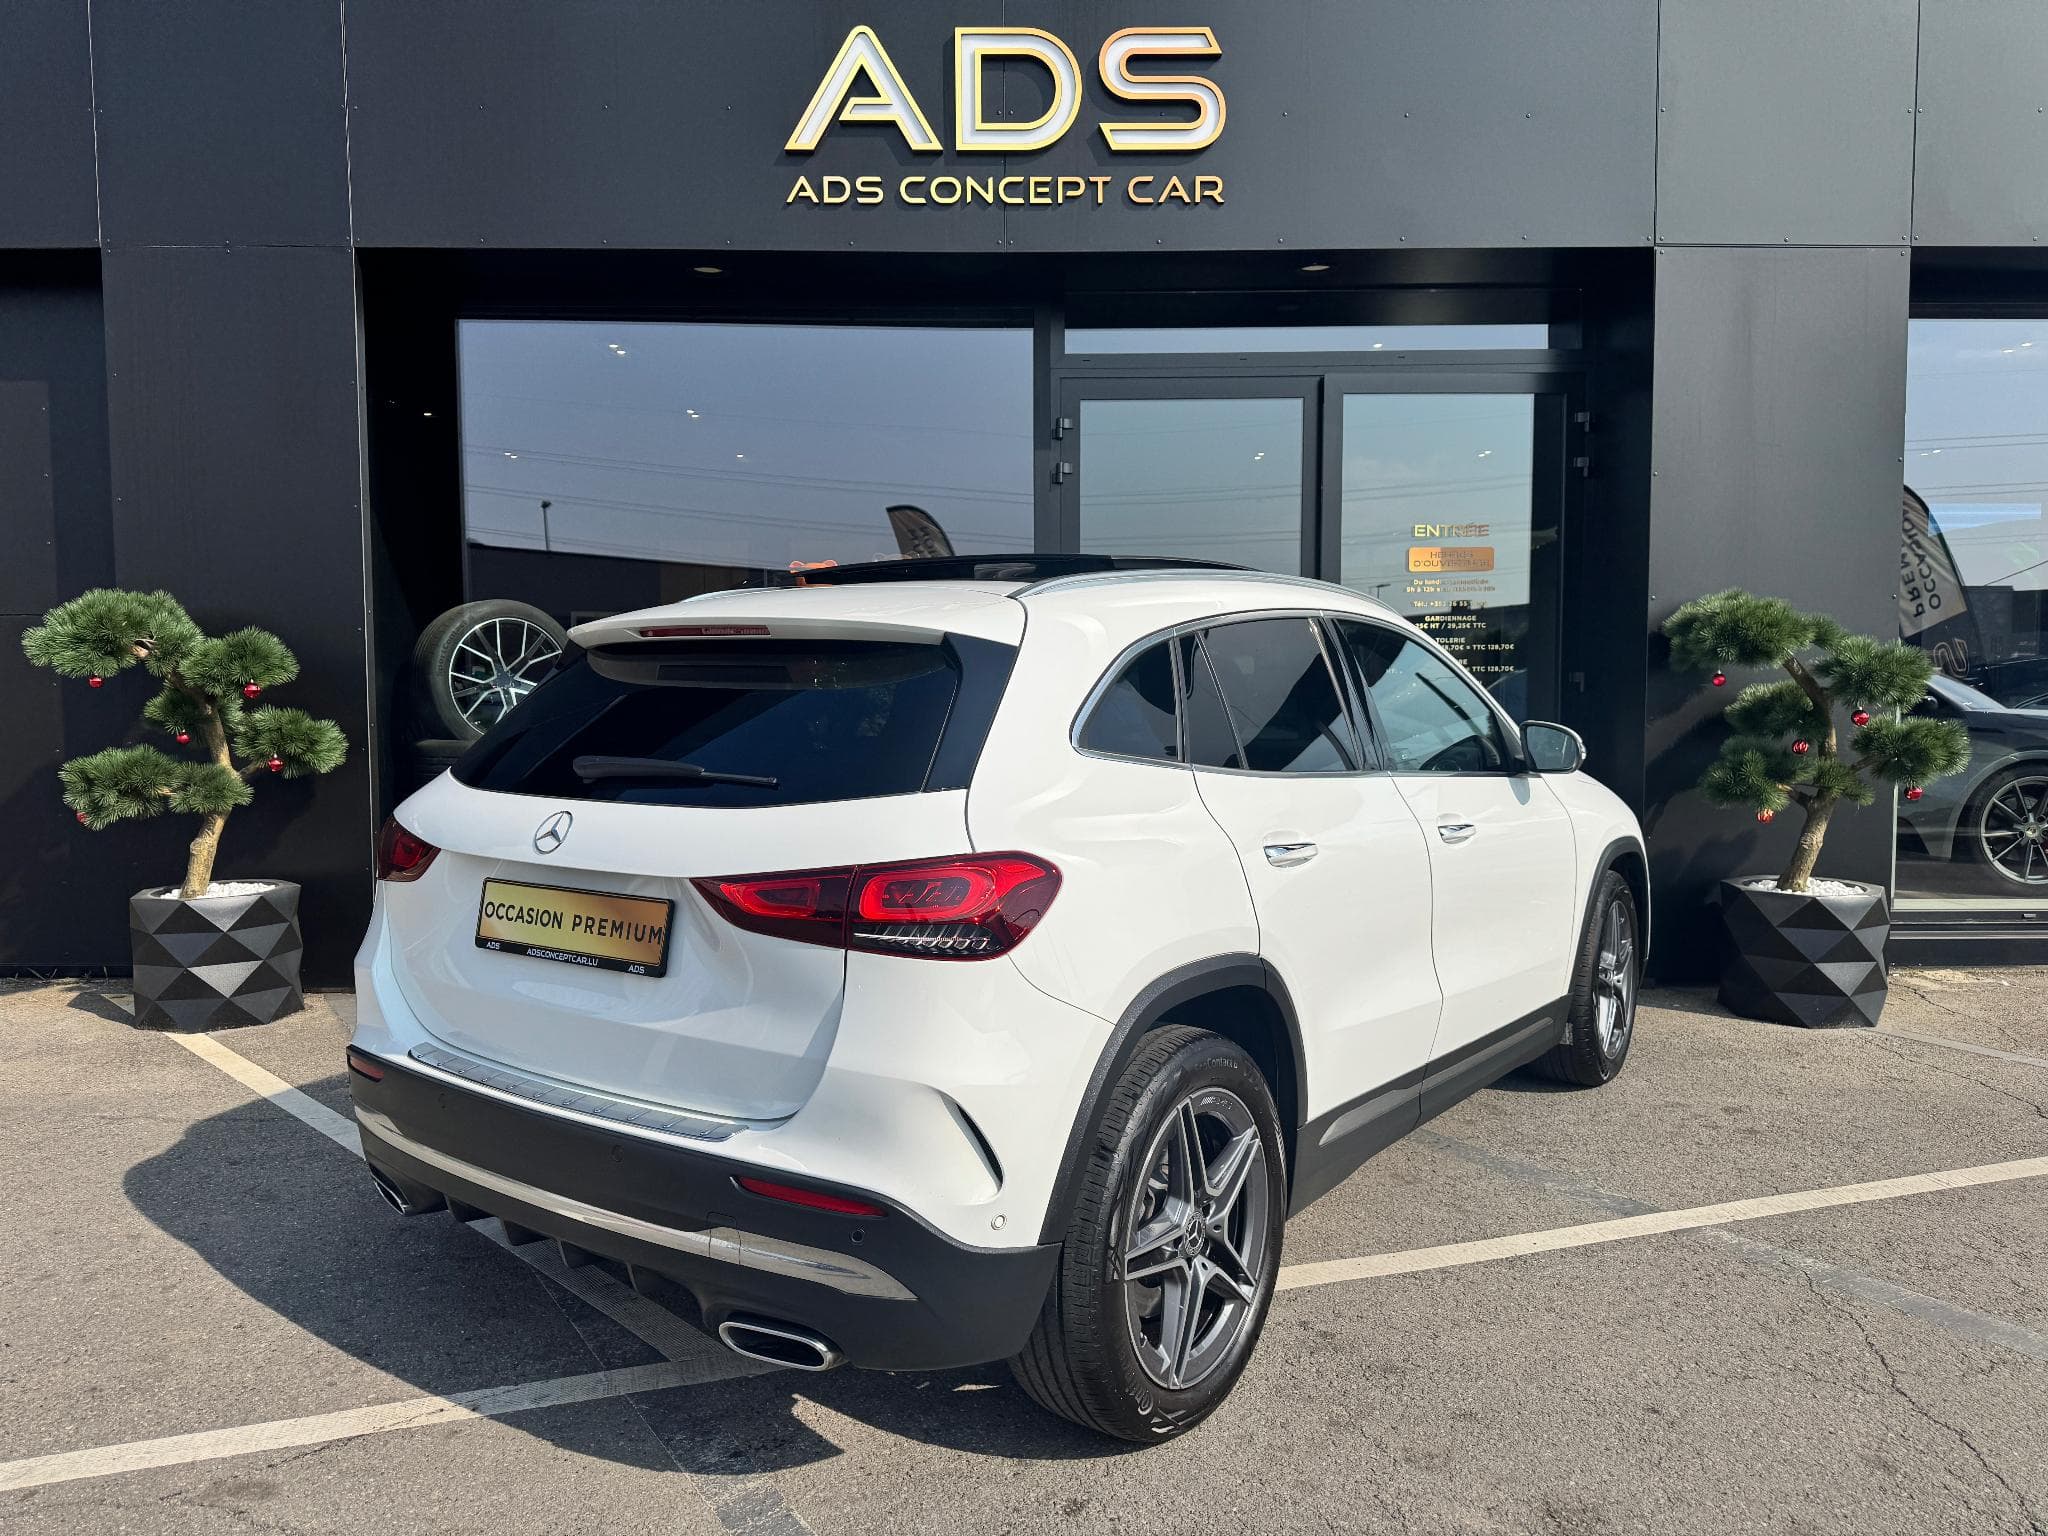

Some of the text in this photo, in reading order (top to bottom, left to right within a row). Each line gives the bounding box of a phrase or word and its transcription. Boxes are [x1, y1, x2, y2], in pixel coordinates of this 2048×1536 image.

[784, 24, 1227, 152] ADS
[786, 175, 1225, 205] ADS CONCEPT CAR
[484, 901, 664, 945] OCCASION PREMIUM
[486, 940, 500, 950] ADS
[526, 947, 599, 967] ADSCONCEPTCAR.LU
[628, 964, 645, 974] ADS
